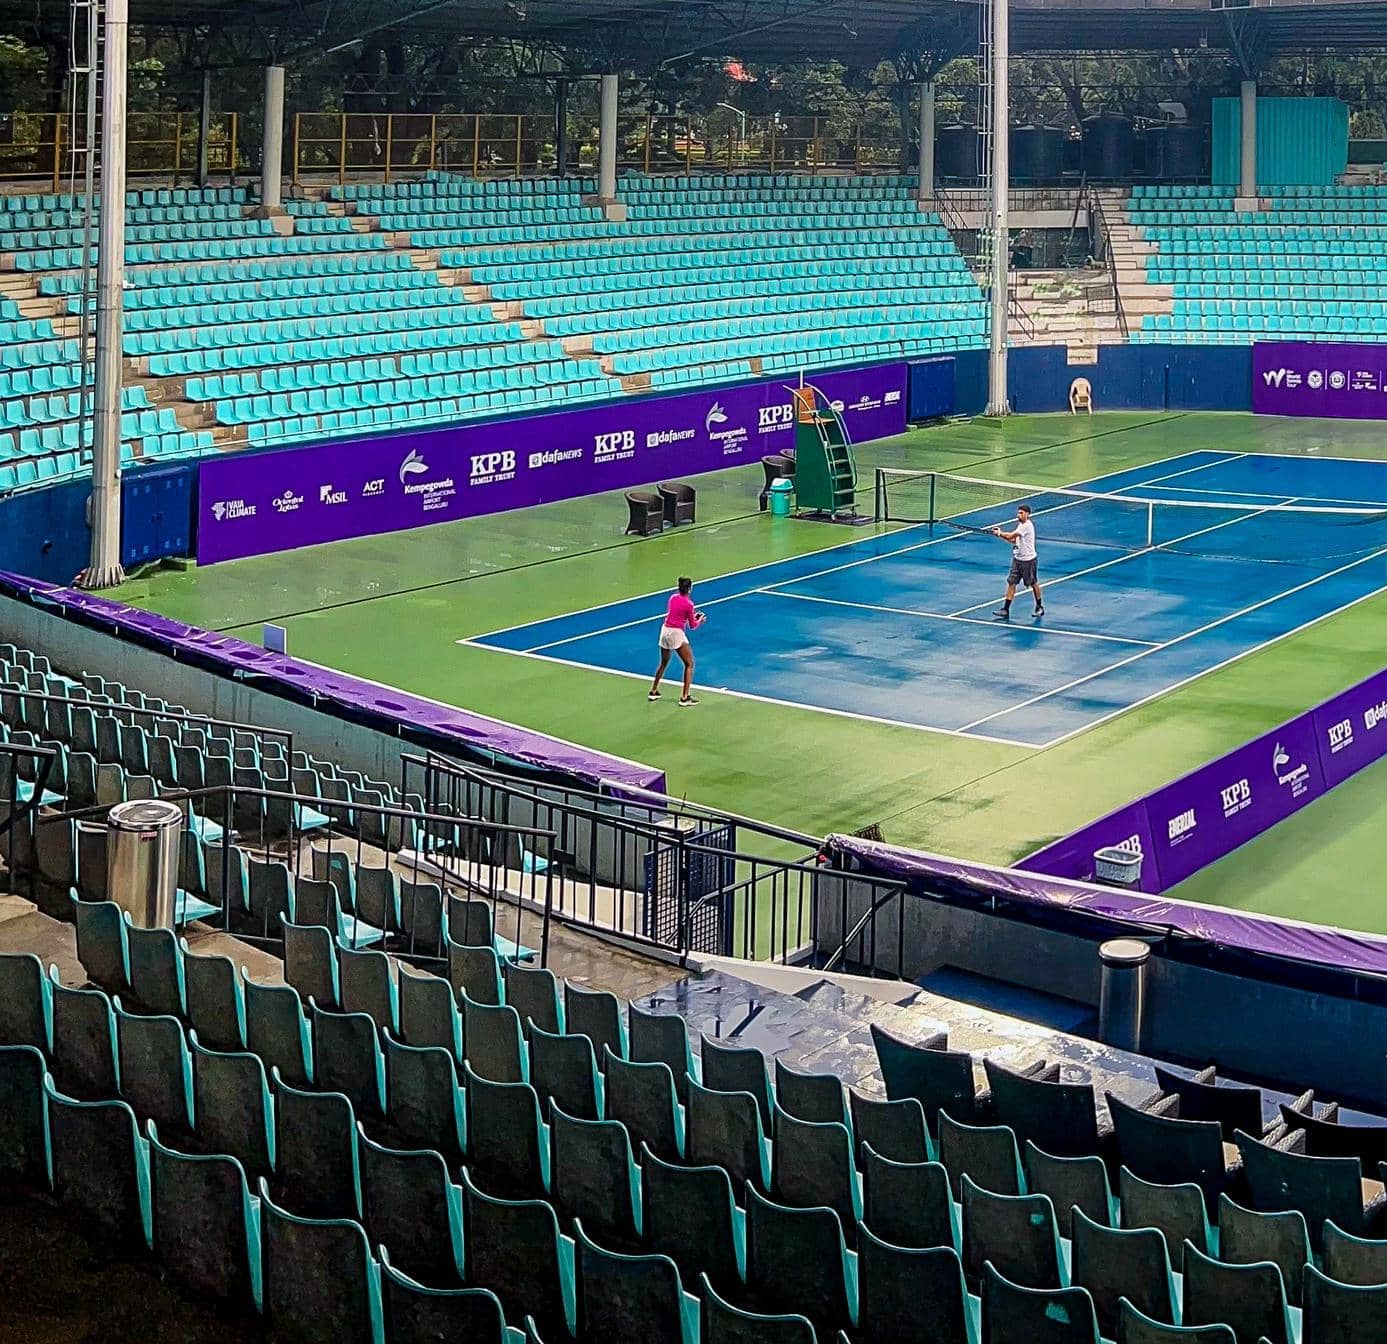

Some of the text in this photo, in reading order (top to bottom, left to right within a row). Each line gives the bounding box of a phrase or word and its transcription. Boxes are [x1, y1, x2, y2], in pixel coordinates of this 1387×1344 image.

[758, 404, 793, 426] KPB
[594, 430, 635, 455] KPB
[470, 450, 516, 477] KPB
[363, 479, 385, 492] ACT
[404, 478, 454, 495] Kempegowda
[325, 491, 348, 505] MSIL
[1328, 718, 1353, 747] KPB
[1220, 778, 1251, 810] KPB
